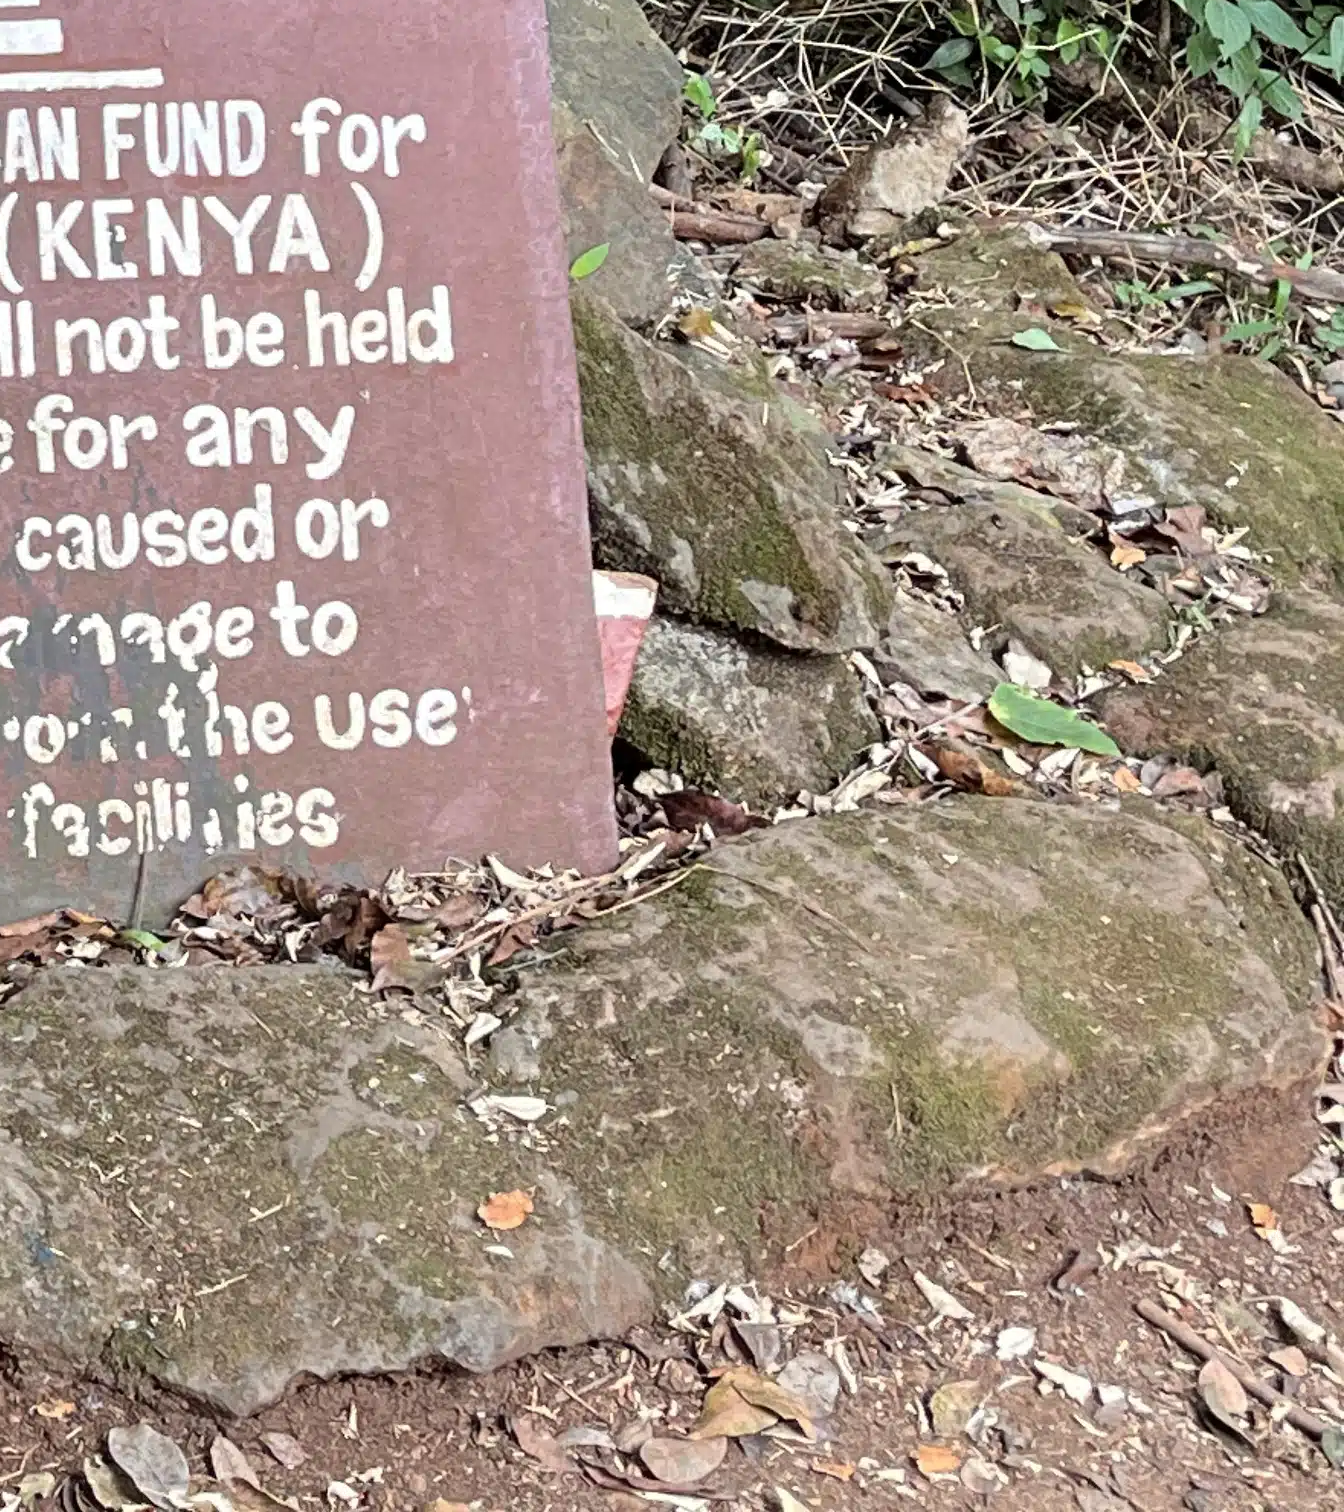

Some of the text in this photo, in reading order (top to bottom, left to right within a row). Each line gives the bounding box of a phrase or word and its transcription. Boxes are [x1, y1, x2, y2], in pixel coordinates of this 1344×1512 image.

[102, 96, 268, 184] FUND
[288, 94, 430, 180] for
[54, 293, 184, 378] not
[198, 292, 290, 372] be
[302, 284, 456, 368] held
[26, 392, 156, 476] for
[178, 398, 360, 482] any
[10, 478, 278, 572] caused
[290, 483, 392, 564] or
[266, 573, 360, 660] to
